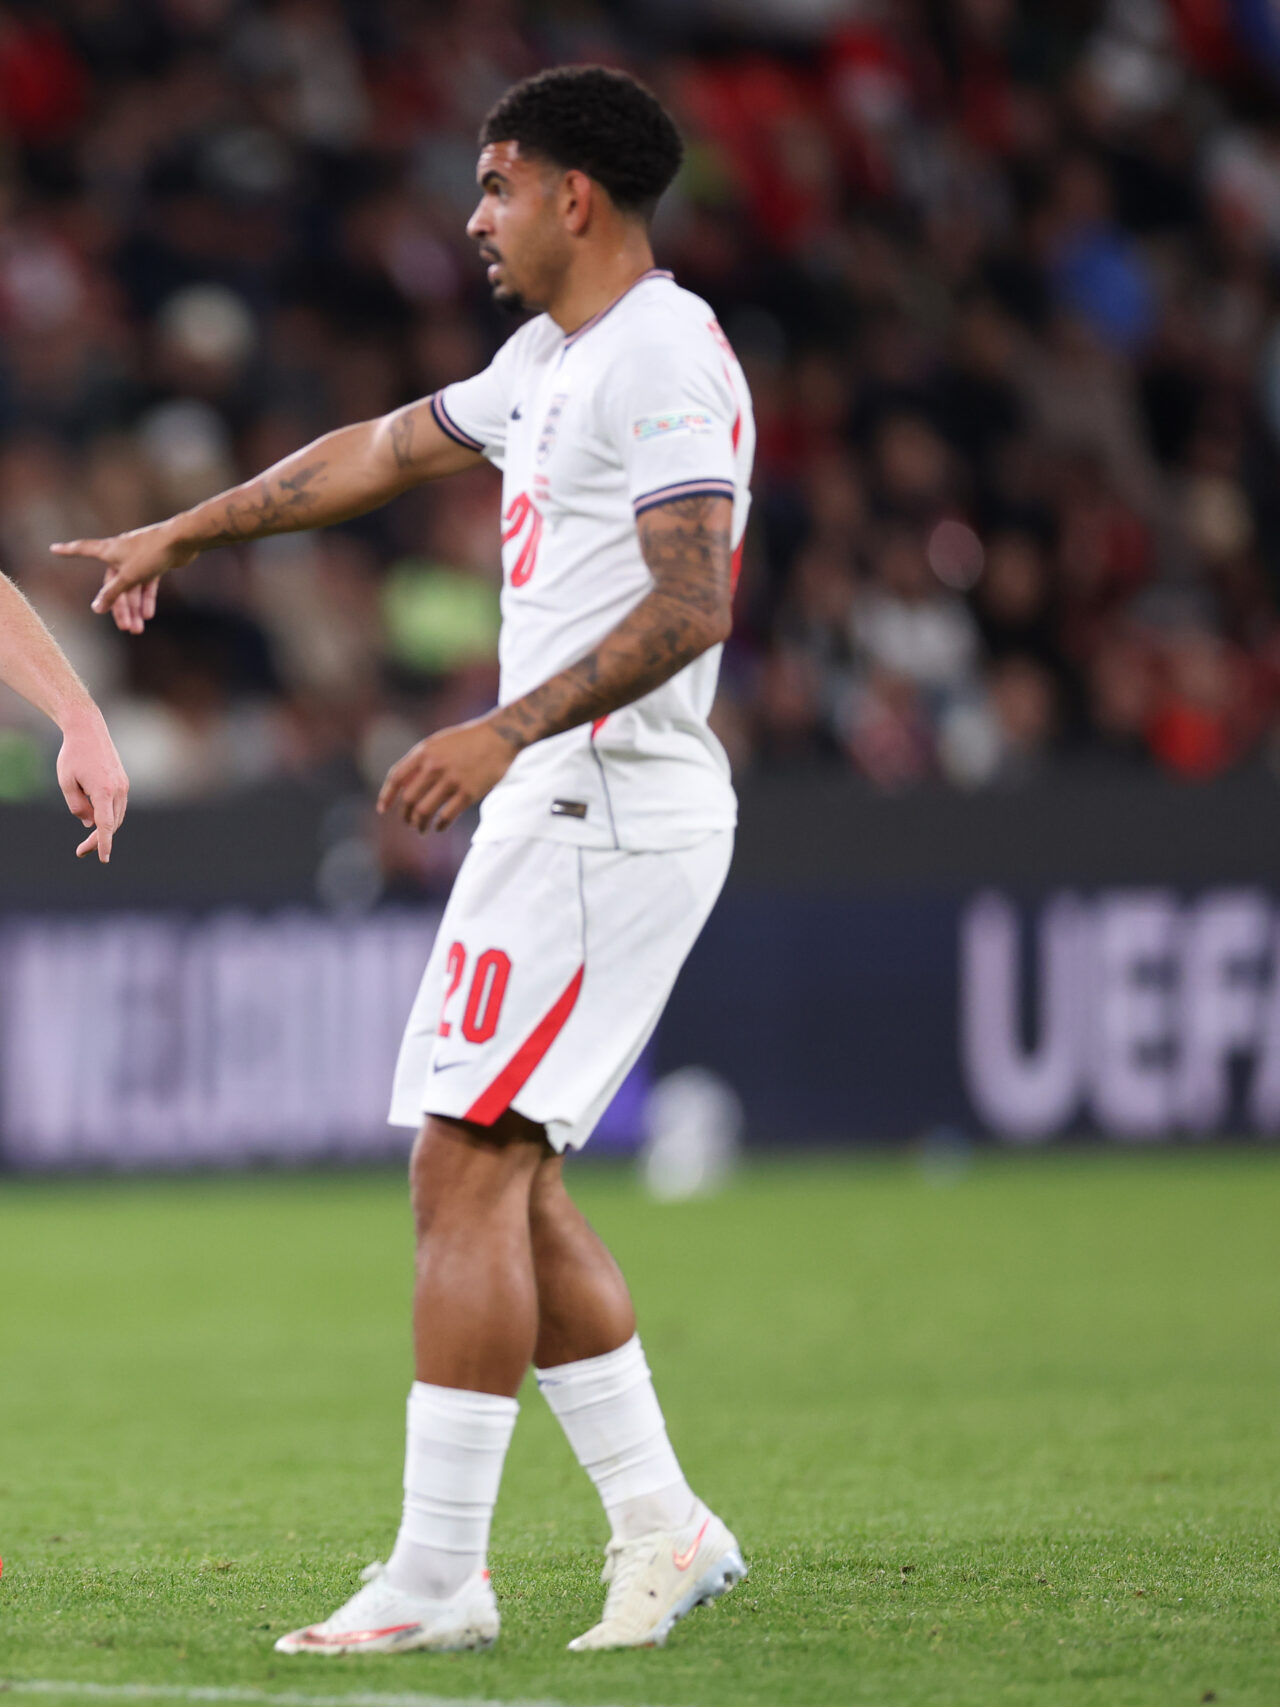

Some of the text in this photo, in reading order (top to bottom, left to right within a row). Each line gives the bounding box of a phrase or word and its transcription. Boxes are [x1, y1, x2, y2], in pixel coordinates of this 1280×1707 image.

[501, 491, 544, 588] 20
[437, 941, 512, 1045] 20
[962, 888, 1280, 1140] UEF
